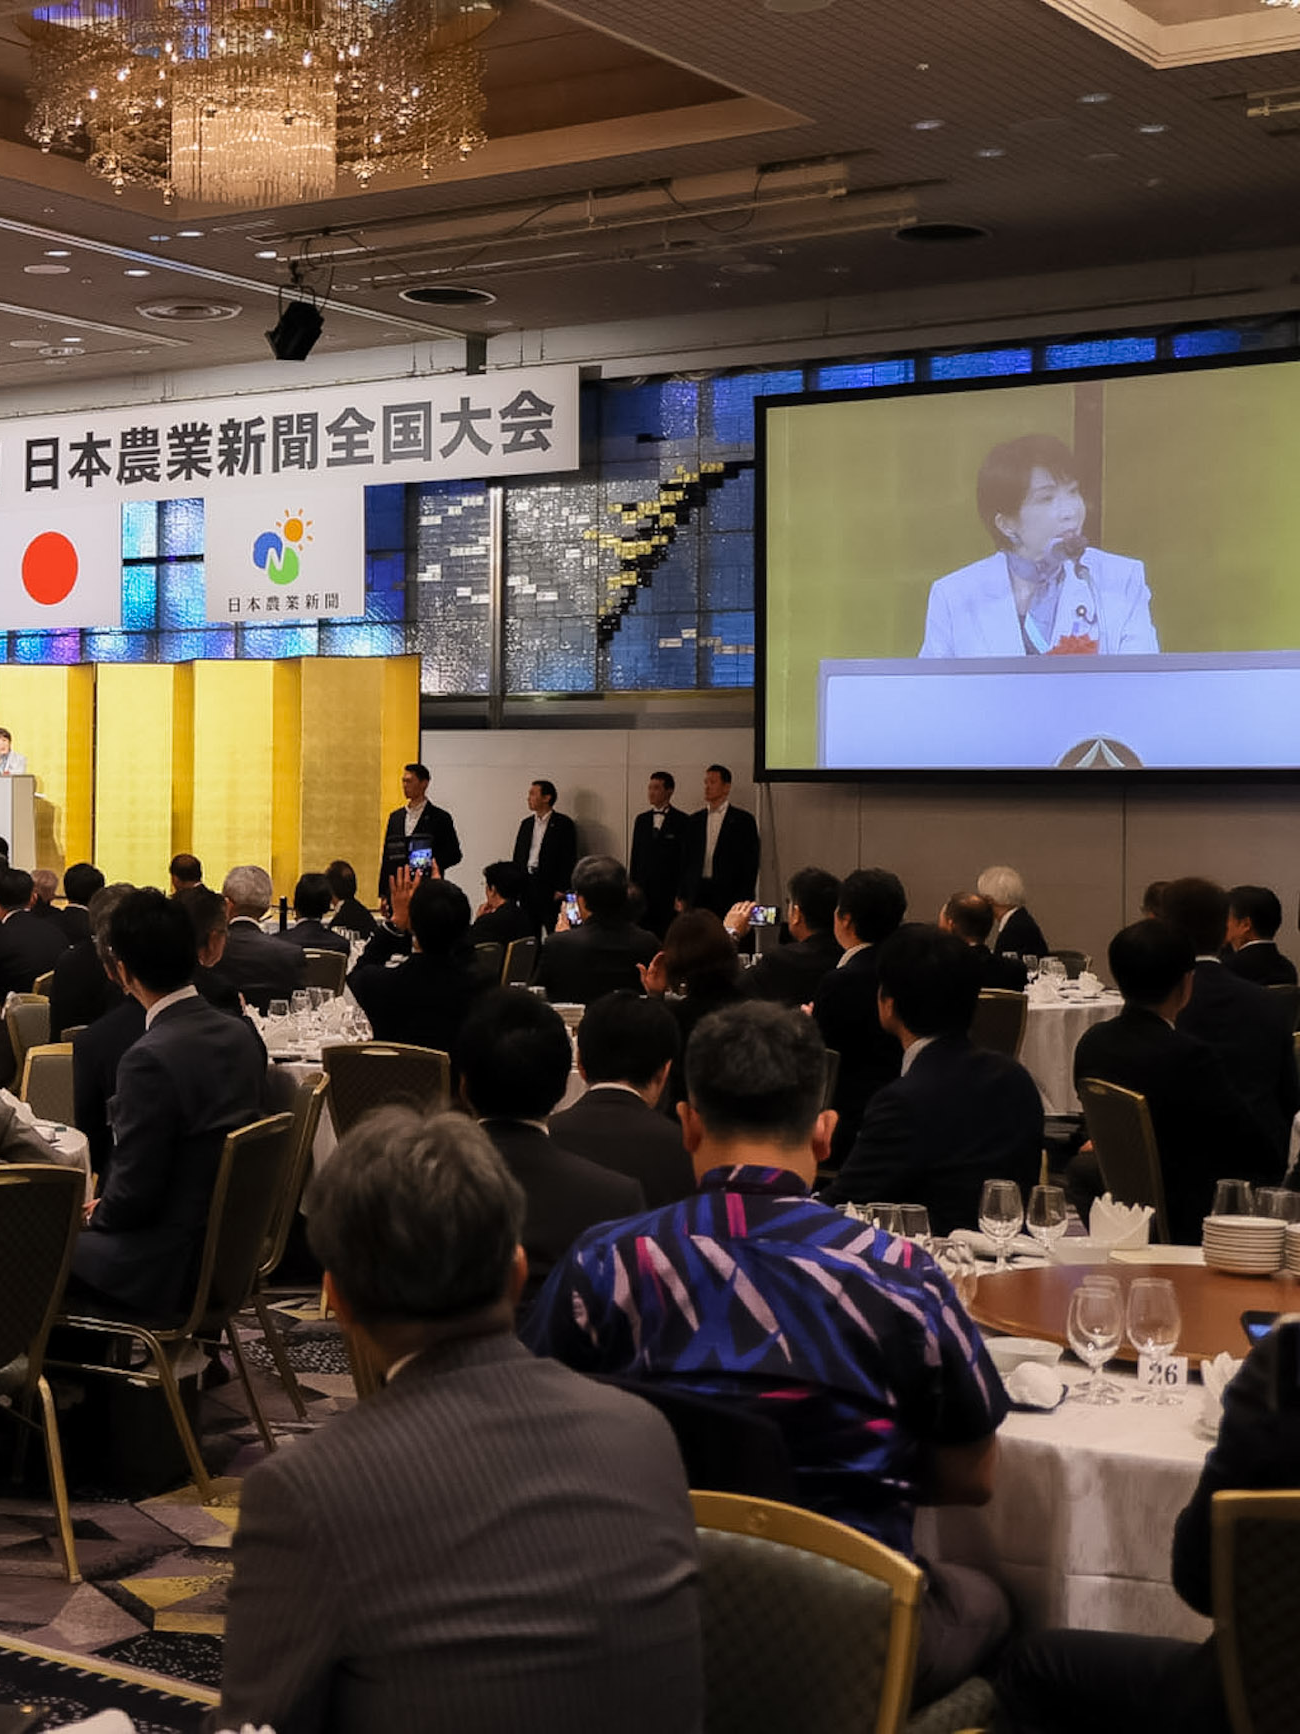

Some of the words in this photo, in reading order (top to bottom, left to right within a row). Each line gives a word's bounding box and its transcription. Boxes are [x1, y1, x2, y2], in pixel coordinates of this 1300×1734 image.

[25, 390, 555, 492] 日本農業新聞全国大会
[228, 592, 340, 613] 日本農業新聞
